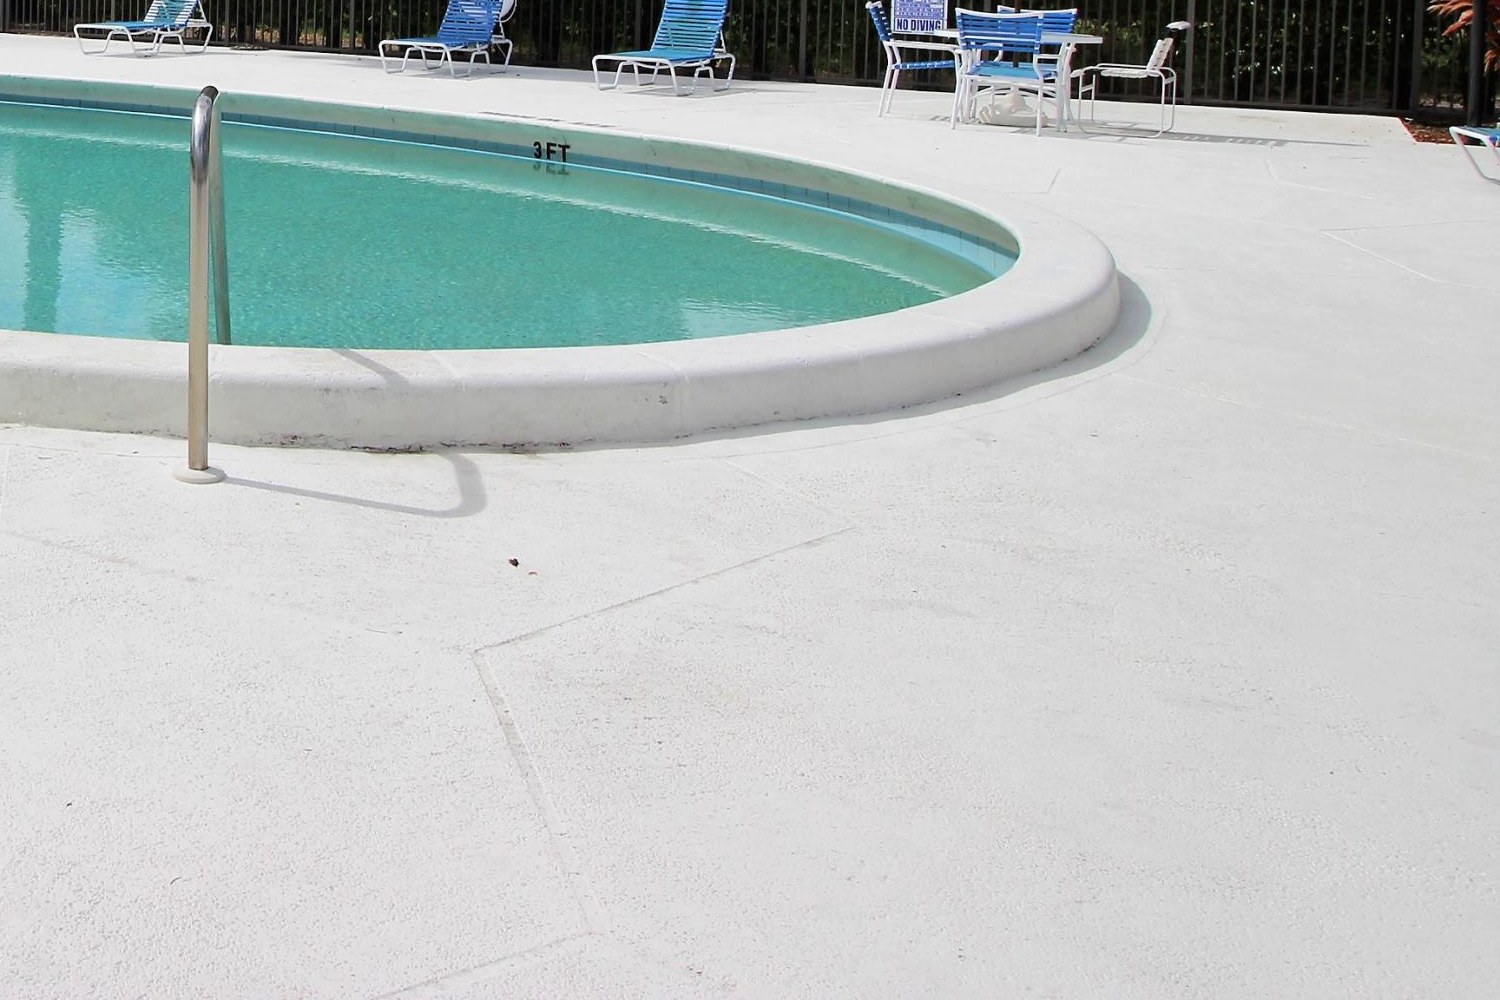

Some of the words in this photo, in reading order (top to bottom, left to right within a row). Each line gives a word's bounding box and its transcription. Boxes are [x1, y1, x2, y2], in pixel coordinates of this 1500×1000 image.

[896, 18, 909, 30] NO
[910, 19, 941, 32] DIVING
[546, 142, 571, 163] FT
